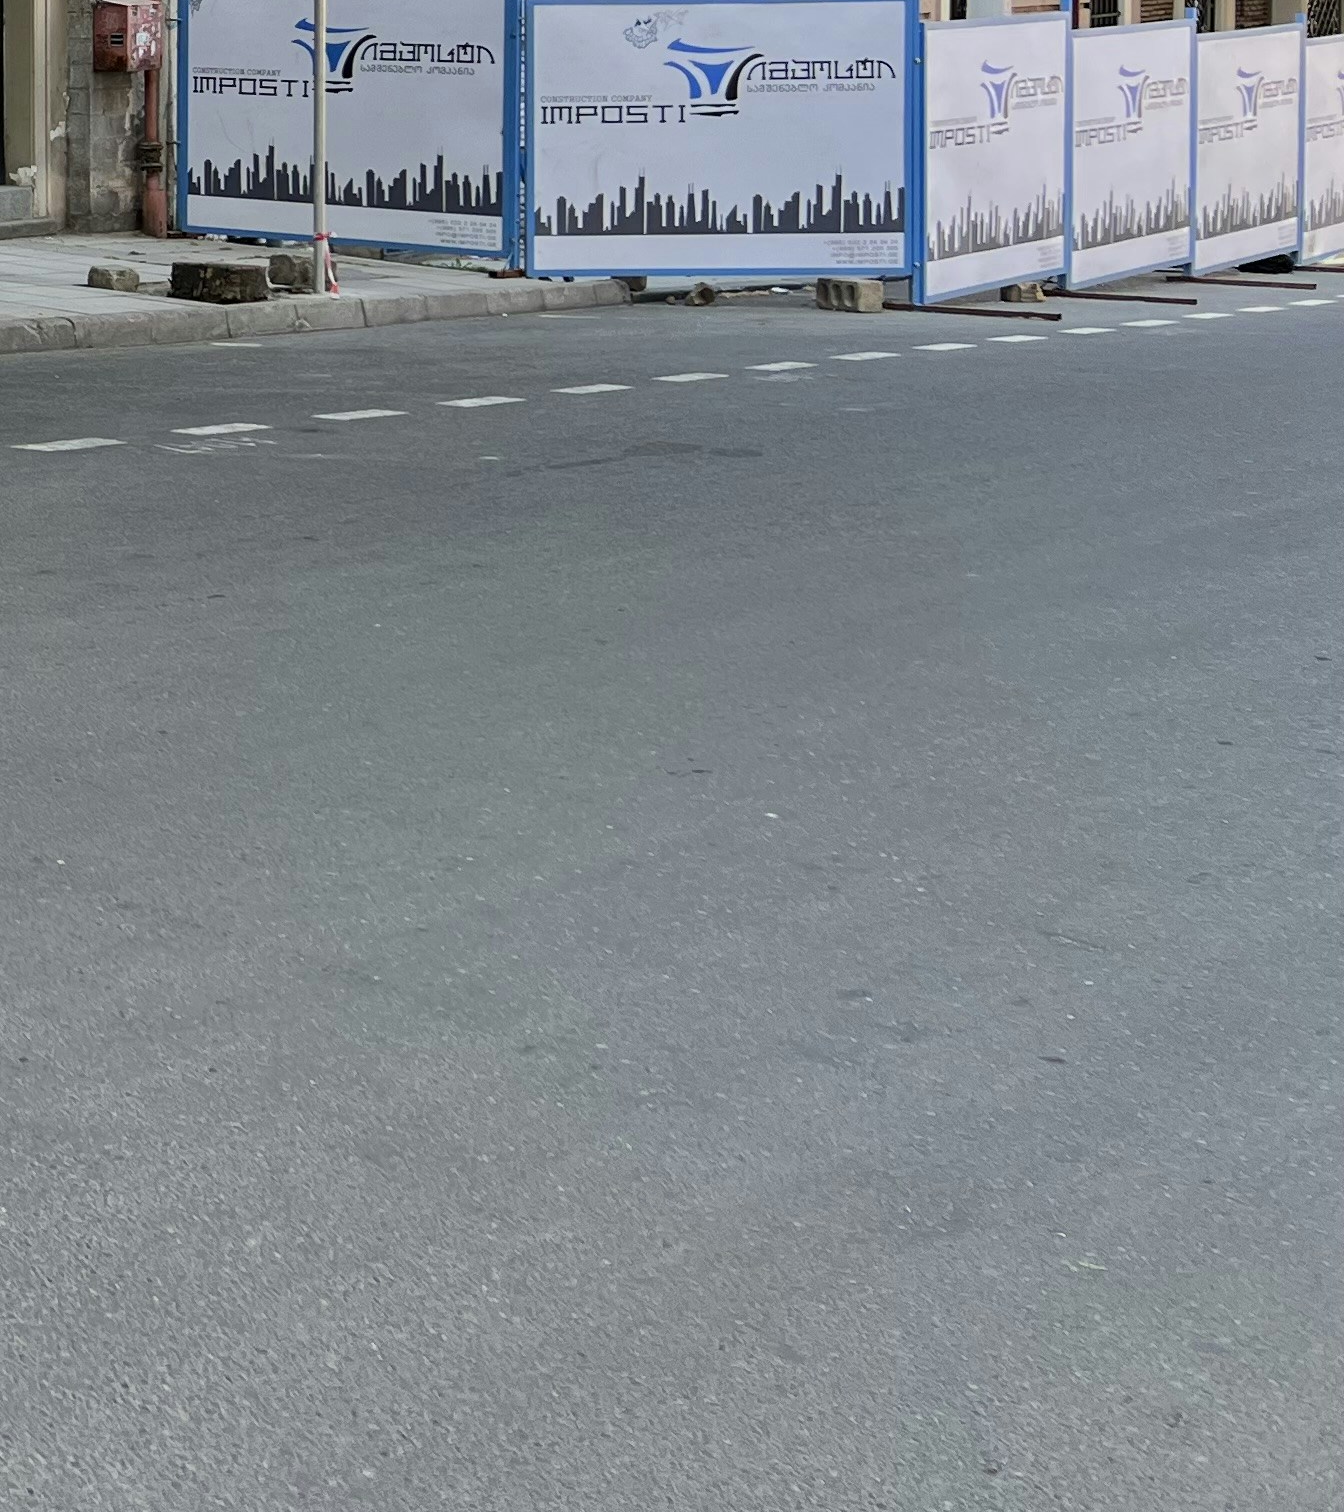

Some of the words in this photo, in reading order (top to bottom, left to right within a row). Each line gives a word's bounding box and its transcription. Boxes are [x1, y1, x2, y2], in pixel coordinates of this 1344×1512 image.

[192, 66, 245, 75] CONSTRUCTION
[246, 68, 281, 76] COMPANY
[193, 76, 309, 97] IMPOSTI
[540, 95, 608, 103] CONSTRUCTION
[611, 94, 653, 103] COMPANY
[540, 105, 686, 124] IMPOSTI
